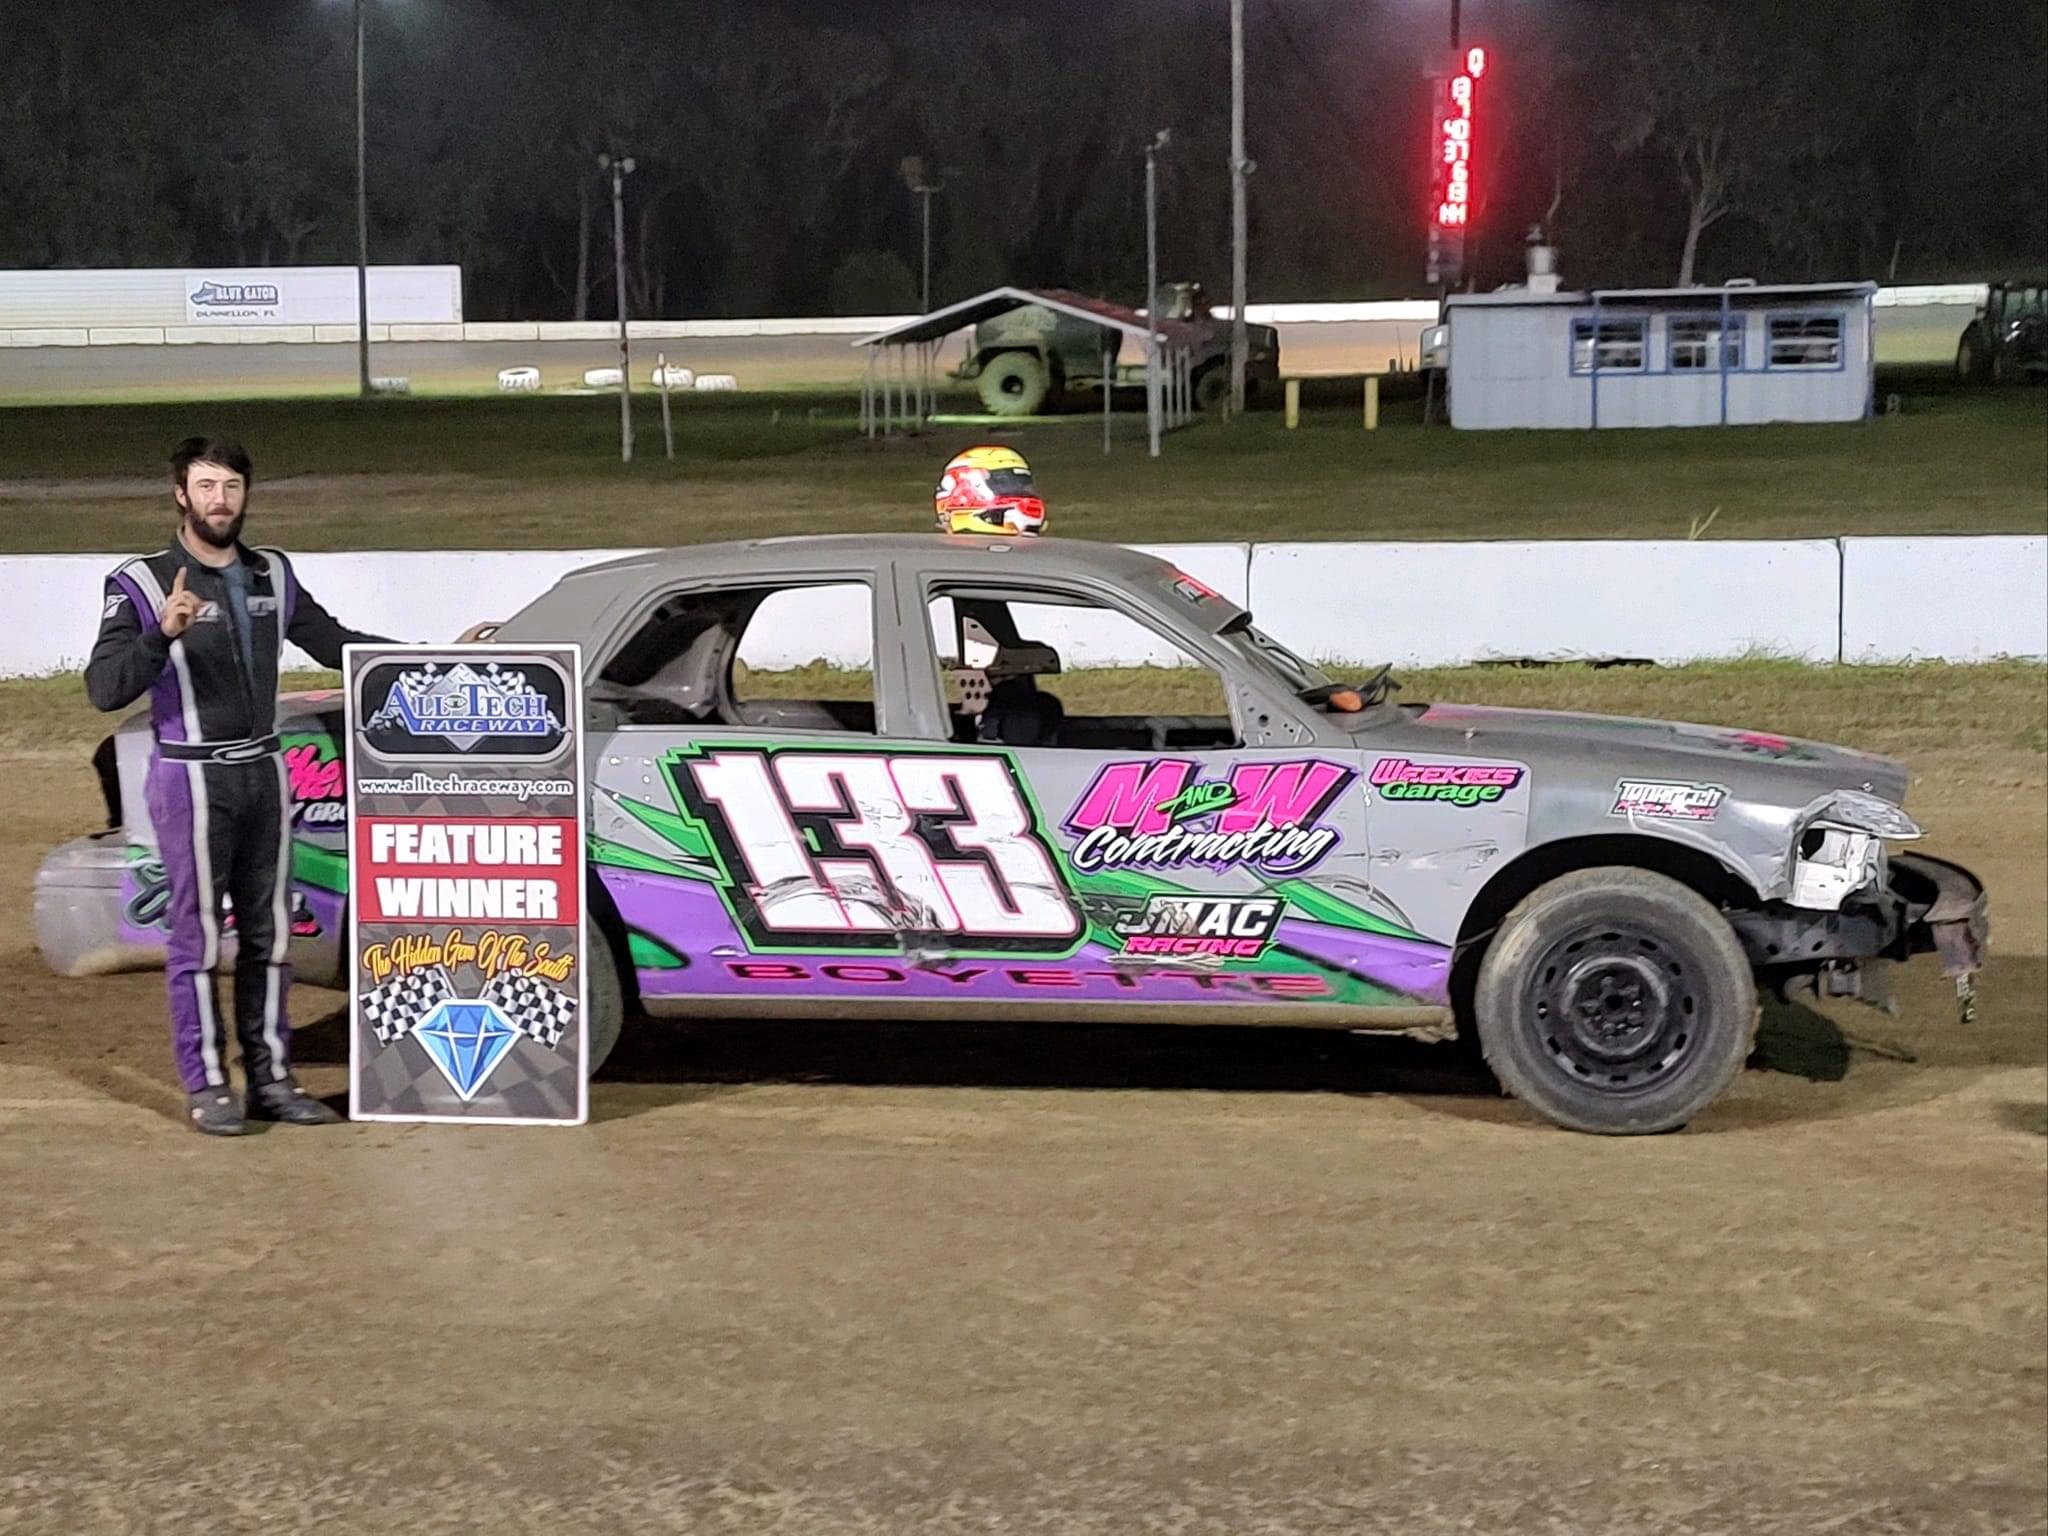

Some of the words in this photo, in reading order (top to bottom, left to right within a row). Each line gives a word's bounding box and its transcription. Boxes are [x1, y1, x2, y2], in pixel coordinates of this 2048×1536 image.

[420, 718, 541, 732] RACEWAY
[358, 773, 574, 801] www.alltechraceway.com
[1066, 760, 1192, 838] M
[1216, 760, 1350, 835] W
[1380, 782, 1504, 806] Garage
[371, 823, 563, 866] FEATURE
[691, 751, 1078, 938] 133
[1073, 819, 1338, 873] Contracting
[375, 877, 560, 919] WINNER
[1113, 898, 1280, 937] JMAC
[363, 944, 392, 985] The
[390, 934, 442, 977] Hidden
[442, 928, 477, 974] Gem
[477, 930, 503, 980] Of
[499, 934, 530, 971] The
[523, 943, 575, 982] South
[1126, 936, 1257, 956] RACING
[724, 962, 1336, 996] BOYETTE
